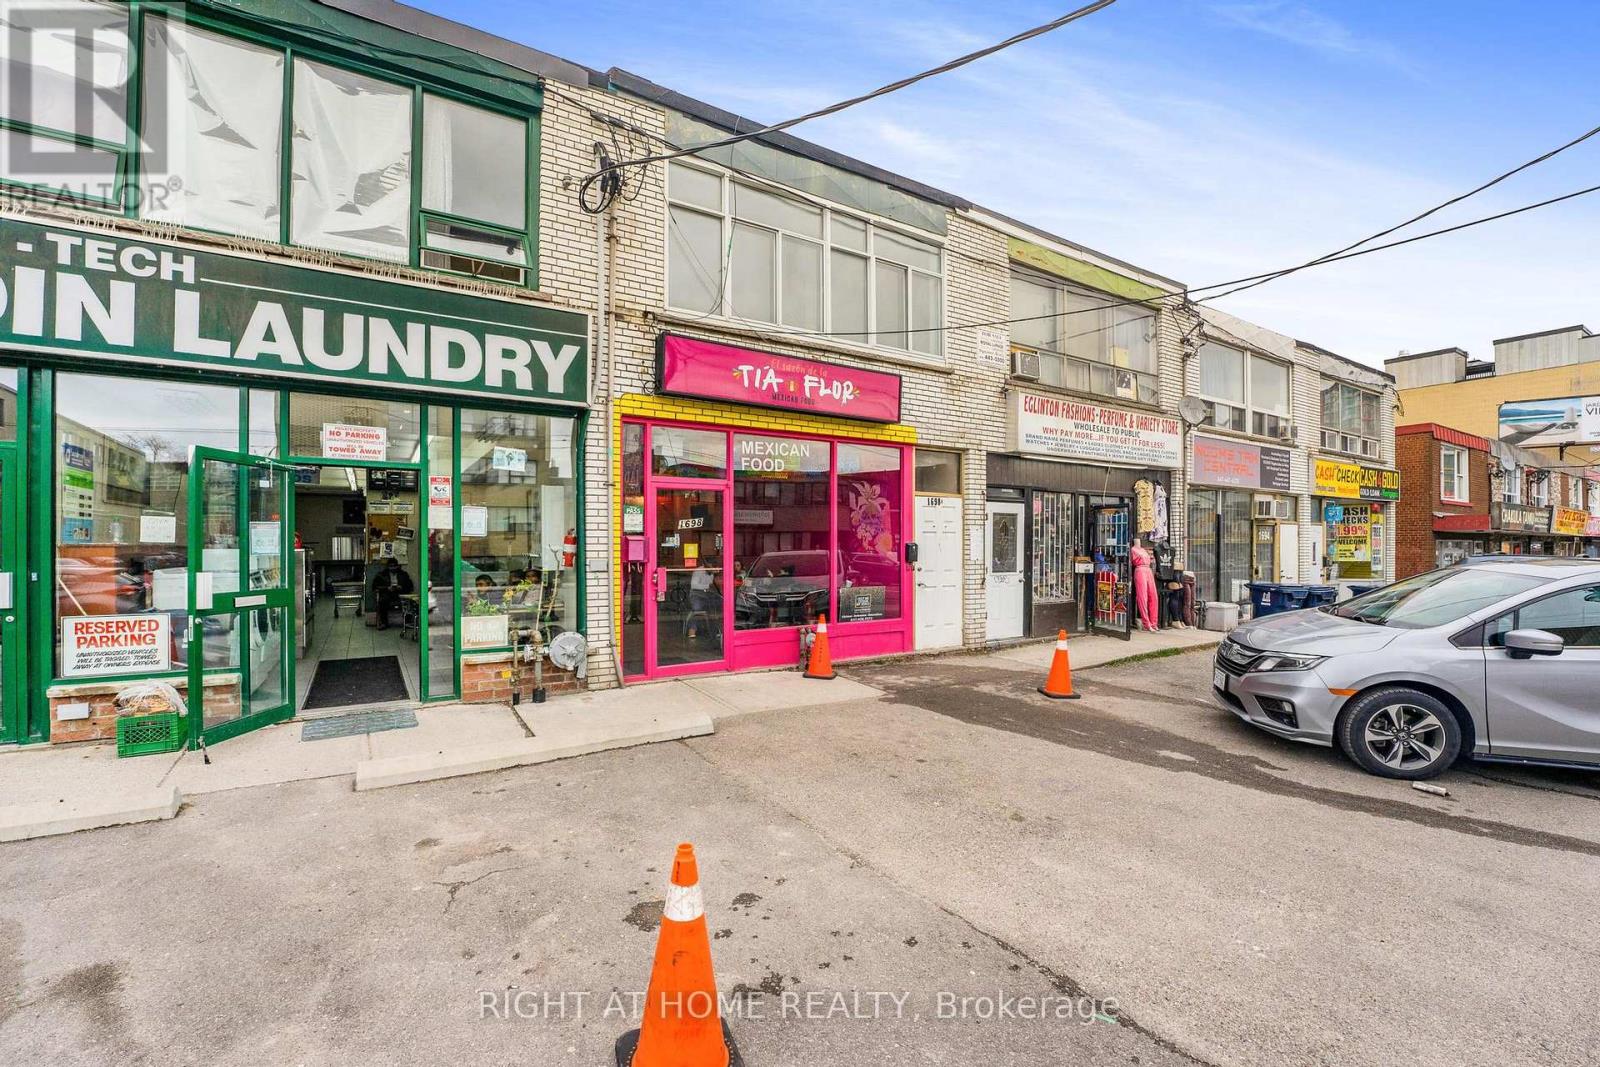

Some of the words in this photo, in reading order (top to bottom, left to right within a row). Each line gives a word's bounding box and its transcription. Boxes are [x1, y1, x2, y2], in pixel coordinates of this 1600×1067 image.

[46, 231, 196, 284] TECH
[0, 265, 135, 348] IN
[173, 288, 580, 394] LAUNDRY
[803, 374, 855, 405] FLOR
[771, 393, 799, 404] MEXICAN
[1023, 395, 1060, 417] EGLINTON
[1061, 401, 1096, 422] FASHIONS
[1099, 405, 1128, 429] PERFUME
[1128, 416, 1135, 428] &
[1135, 415, 1160, 434] VARIETY
[1161, 418, 1179, 436] STORE
[345, 431, 381, 440] PARKING
[1042, 426, 1059, 435] WHY
[1060, 429, 1074, 438] PAY
[1105, 435, 1119, 444] YOU
[1119, 437, 1131, 445] GET
[1138, 439, 1150, 448] FOR
[1073, 421, 1110, 434] WHOLESALE
[1111, 428, 1120, 436] TO
[1120, 428, 1141, 439] PUBLIC
[328, 446, 356, 454] TOWED
[741, 440, 810, 457] MEXICAN
[1025, 438, 1050, 446] WATCHES
[741, 457, 785, 472] FOOD
[1315, 465, 1335, 481] CASH
[1336, 467, 1360, 484] CHECK
[1360, 469, 1377, 487] CASH
[1382, 472, 1399, 489] GOLD
[1343, 506, 1369, 516] ASH
[680, 518, 703, 528] 1698
[74, 618, 160, 635] RESERVED
[76, 633, 157, 649] PARKING
[132, 659, 161, 667] EXPENSE
